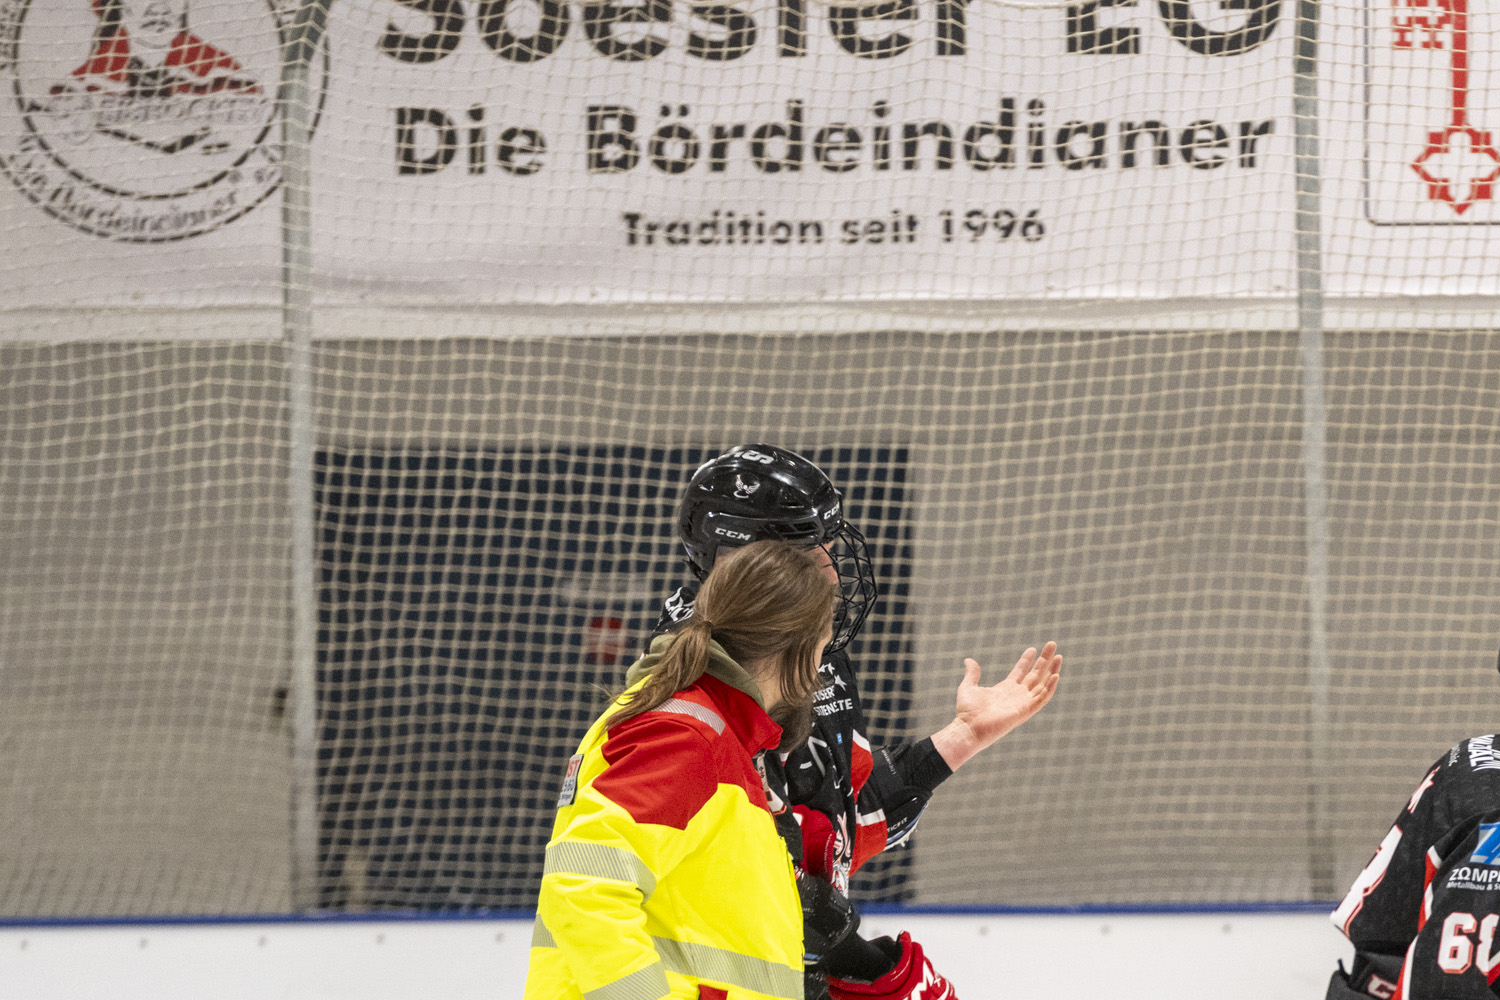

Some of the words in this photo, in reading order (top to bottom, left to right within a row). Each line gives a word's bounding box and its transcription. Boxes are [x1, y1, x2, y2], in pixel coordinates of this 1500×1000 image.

[396, 103, 547, 176] Die
[586, 97, 1275, 176] Bördeindianer
[621, 210, 824, 246] Tradition
[840, 208, 919, 245] seit
[937, 208, 1046, 244] 1996
[714, 527, 752, 541] CCM
